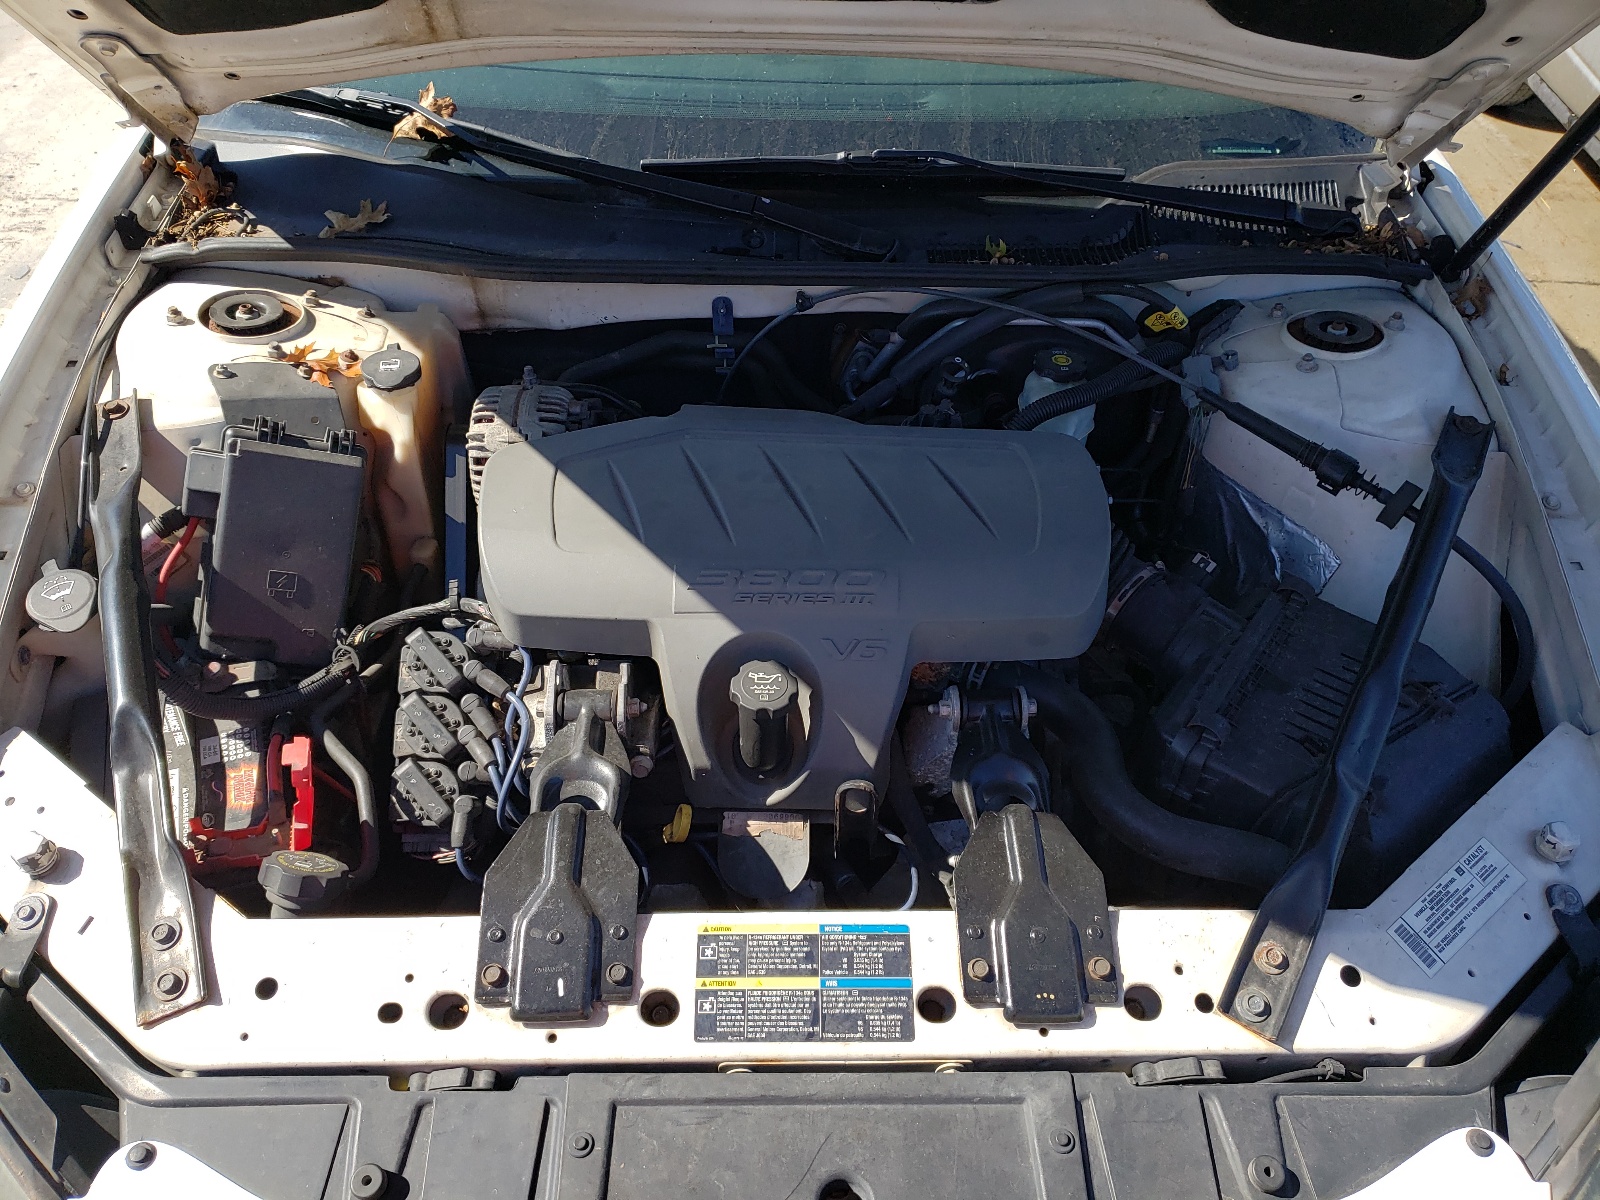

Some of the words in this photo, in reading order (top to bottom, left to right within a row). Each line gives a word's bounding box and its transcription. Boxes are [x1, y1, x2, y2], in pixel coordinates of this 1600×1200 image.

[688, 567, 886, 590] 3800
[732, 593, 836, 605] SERIES
[820, 638, 888, 661] V6
[1464, 845, 1485, 866] CATALYST
[1414, 904, 1429, 918] VEHICLE
[1442, 877, 1457, 892] CONTROL
